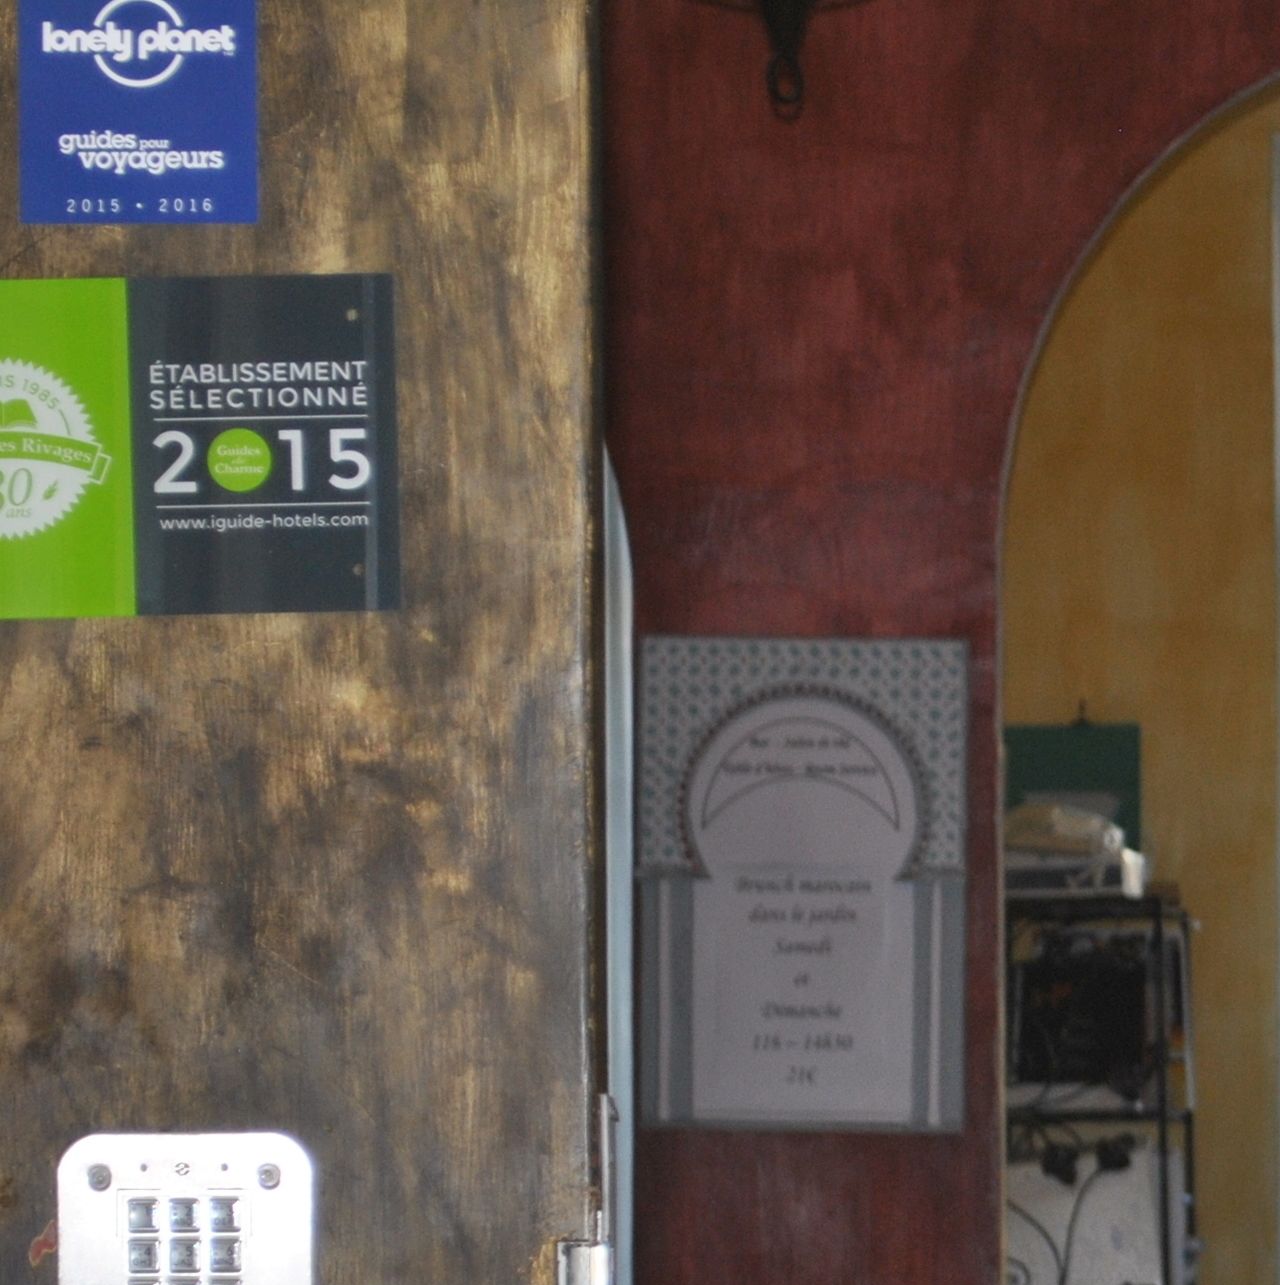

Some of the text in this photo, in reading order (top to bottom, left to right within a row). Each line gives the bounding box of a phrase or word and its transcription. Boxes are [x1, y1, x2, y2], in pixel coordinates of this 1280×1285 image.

[42, 21, 235, 62] lonely planet
[58, 130, 169, 154] guides pour
[78, 150, 224, 175] voyageurs
[66, 198, 214, 213] 2015 2016
[149, 360, 367, 386] ÉTABLISSEMENT
[22, 379, 60, 410] 1985
[149, 383, 368, 410] SÉLECTIONNÉ
[22, 438, 92, 464] Rivages
[217, 444, 262, 457] Guides
[215, 462, 265, 474] Charme
[6, 507, 32, 519] ans
[159, 511, 369, 532] www.iguide-hotels.com
